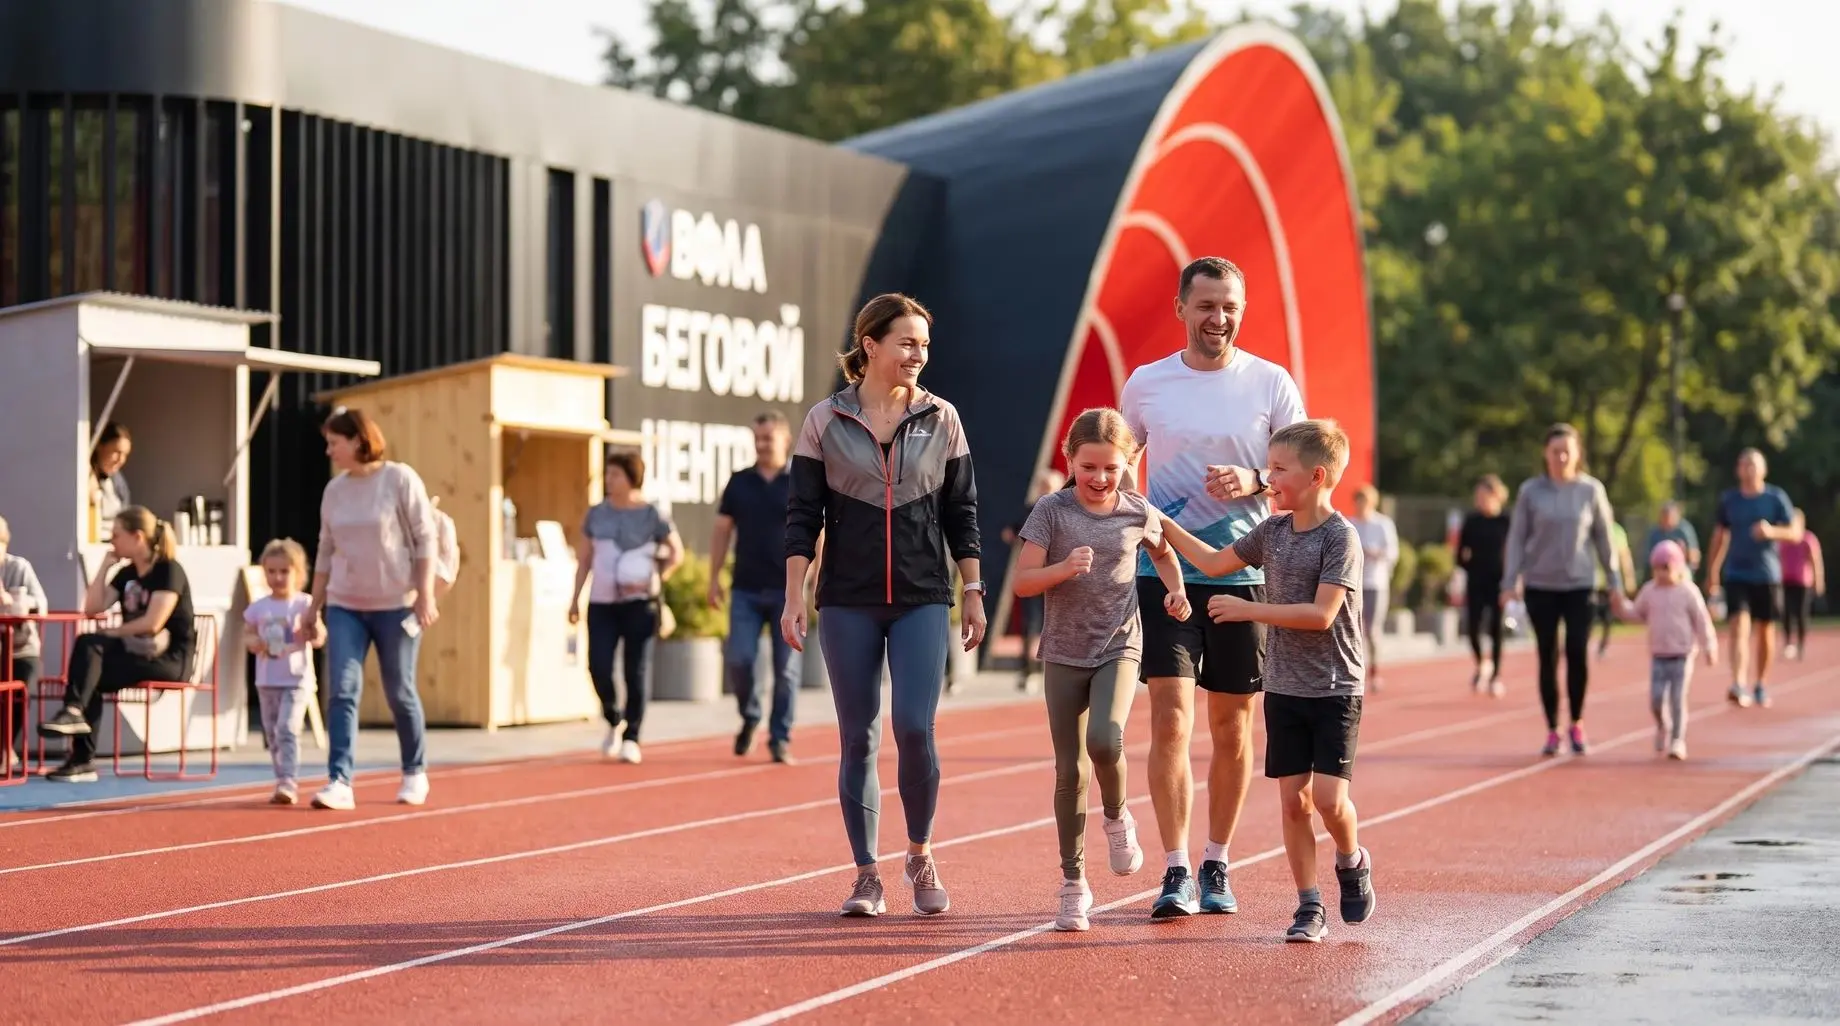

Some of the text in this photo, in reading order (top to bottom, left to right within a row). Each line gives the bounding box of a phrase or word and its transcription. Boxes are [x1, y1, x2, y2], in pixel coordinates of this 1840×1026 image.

[671, 208, 768, 294] ВФЛА
[642, 303, 804, 403] БЕГОВОЙ
[641, 418, 757, 520] ЦЕНТР
